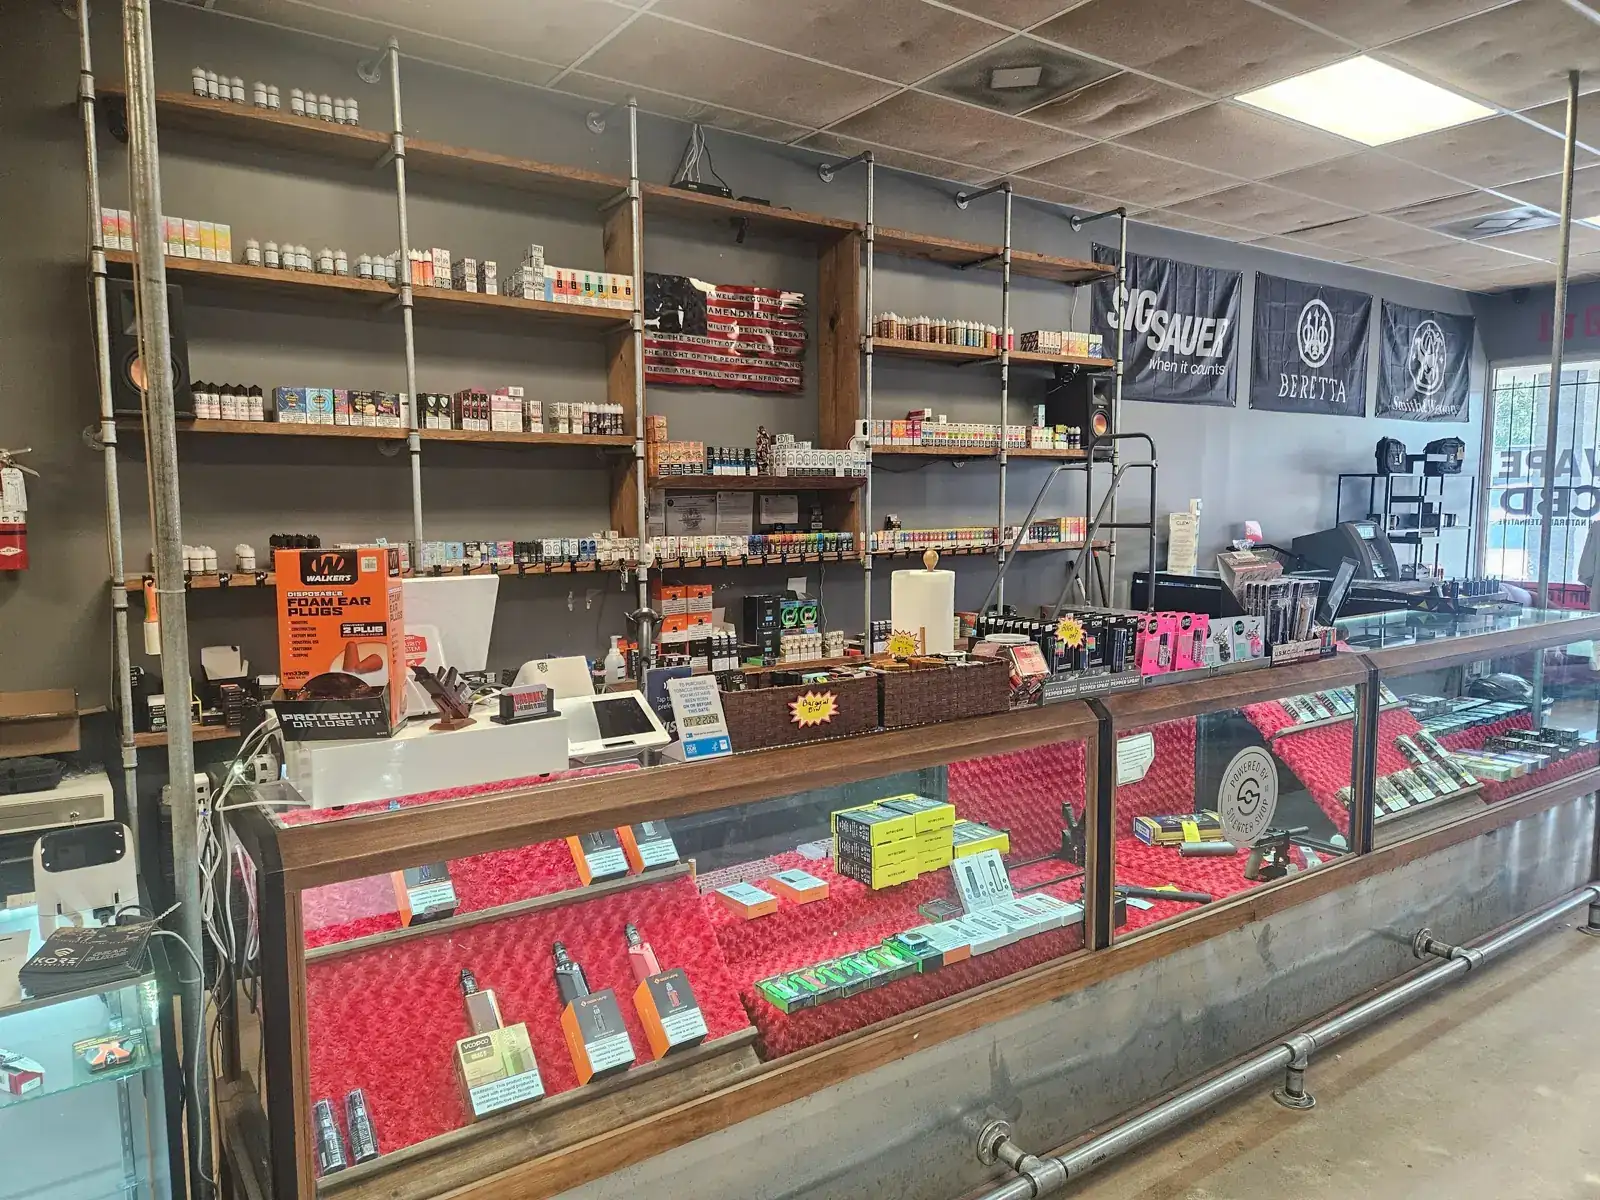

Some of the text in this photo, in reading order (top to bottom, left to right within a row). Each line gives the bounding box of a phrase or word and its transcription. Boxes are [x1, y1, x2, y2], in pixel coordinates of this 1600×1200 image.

[715, 293, 737, 301] WELL
[739, 295, 783, 306] REGULATED
[707, 306, 775, 320] AMENDMENT
[1107, 286, 1157, 333] SIG
[707, 323, 736, 333] MILITIA
[1147, 310, 1229, 358] SAUER
[686, 337, 722, 347] SECURITY
[662, 350, 689, 359] RIGHT
[719, 356, 750, 364] PEOPLE
[673, 367, 696, 375] ARMS
[698, 369, 722, 378] SHALL
[1150, 358, 1226, 376] when it counts
[1278, 373, 1346, 403] BERETTA
[1392, 395, 1421, 412] Smith
[306, 574, 352, 582] WALKER'S
[287, 596, 371, 607] FOAM EAR
[287, 607, 343, 617] PLUGS
[353, 625, 384, 634] PLUG
[1079, 684, 1096, 692] PEPPER
[281, 710, 382, 722] PROTECT IT
[316, 719, 355, 728] LOSE
[359, 718, 375, 726] IT!
[1230, 760, 1268, 788] POWERED BY
[1227, 798, 1269, 834] SILENCER SHOP
[32, 957, 79, 965] KORE
[463, 1038, 489, 1050] VOOPOO
